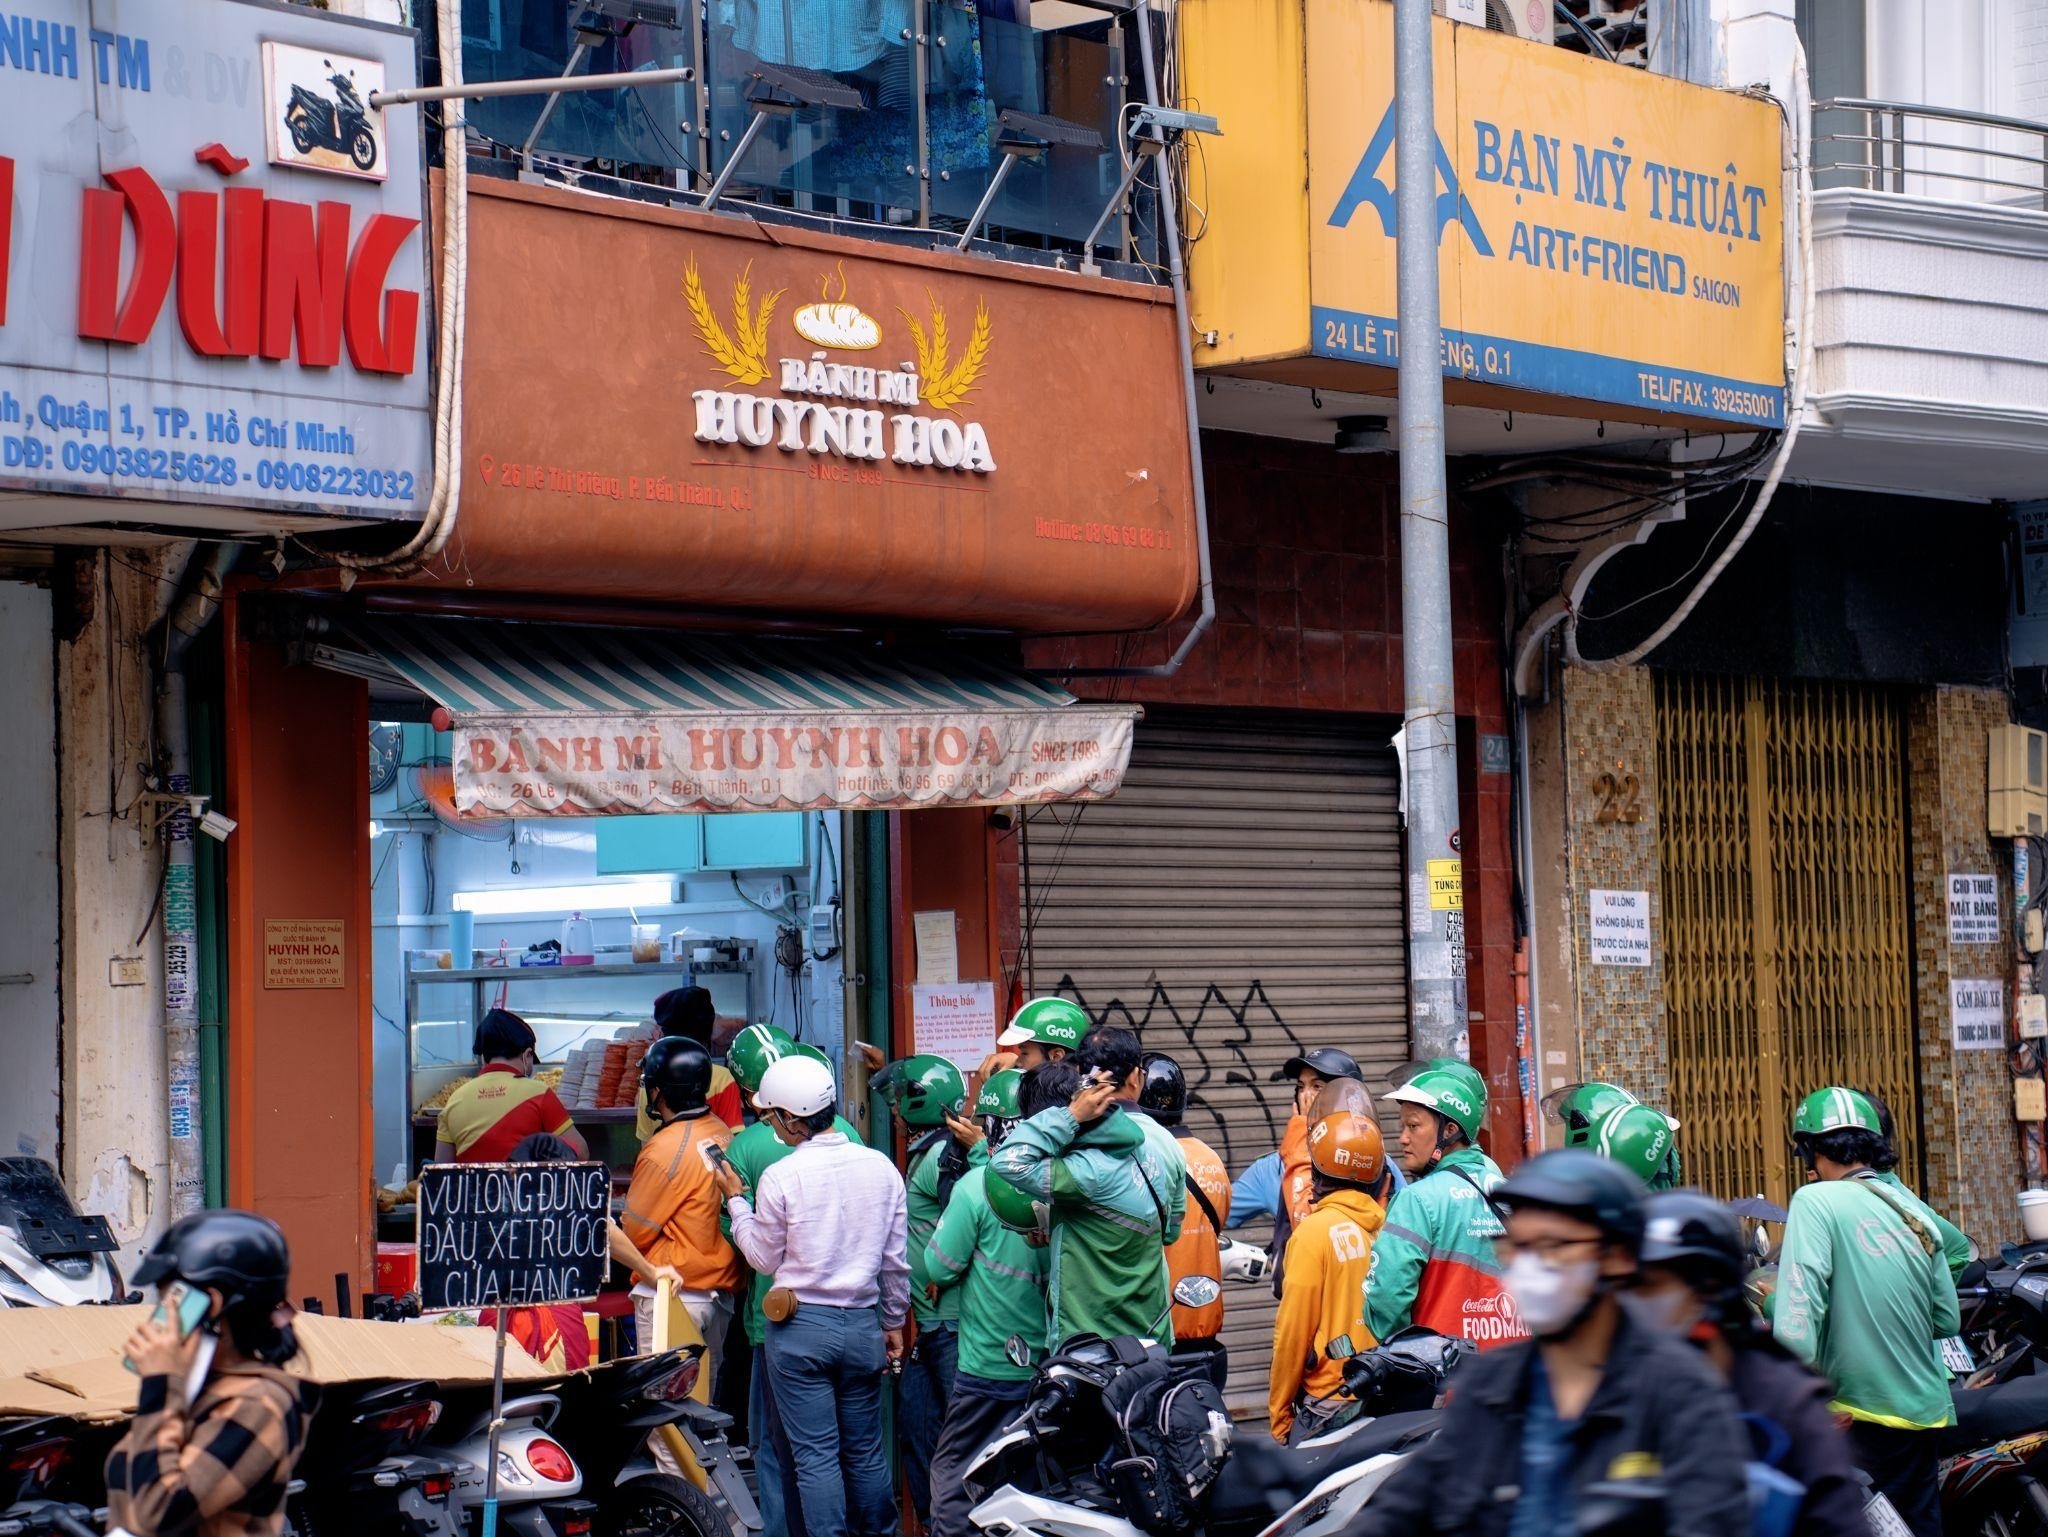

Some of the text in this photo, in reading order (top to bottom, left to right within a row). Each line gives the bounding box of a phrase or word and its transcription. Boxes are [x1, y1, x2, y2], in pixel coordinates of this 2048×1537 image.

[91, 33, 151, 91] TM
[1474, 120, 1767, 252] BẠN MỸ THUẬT
[1693, 275, 1740, 307] SAIGON
[1325, 320, 1348, 349] 24
[1353, 320, 1377, 353] LÊ
[1485, 346, 1512, 375] Q.1
[779, 351, 876, 400] BÁNH
[1638, 373, 1776, 418] TEL/FAX: 39255001
[38, 395, 110, 437] Quận
[153, 407, 197, 440] TP.
[206, 408, 240, 444] Hồ
[247, 416, 288, 449] Chí
[295, 421, 354, 455] Minh
[692, 390, 997, 472] HUYNH HOA
[62, 440, 237, 486] 0903825628
[257, 460, 414, 500] 0908223032
[501, 463, 521, 488] 26
[526, 465, 544, 490] Lê
[550, 467, 572, 497] Thị
[645, 476, 674, 502] Bến
[808, 463, 849, 484] SINCE
[1035, 516, 1082, 541] Hotline:
[469, 725, 1099, 773] BÁNH MÌ HUYNH HOA SINCE 1989
[511, 782, 533, 798] 26
[537, 781, 555, 798] Lê
[837, 775, 893, 791] Hotline:
[916, 774, 931, 789] 96
[1592, 772, 1640, 823] 22
[1604, 896, 1616, 906] VUI
[1636, 918, 1645, 929] XE
[268, 944, 340, 955] HUYNH HOA
[928, 994, 975, 1010] Thông báo
[1046, 1024, 1077, 1040] Grab
[1441, 1091, 1472, 1116] Grab
[1351, 1159, 1373, 1169] Food
[1645, 1129, 1666, 1162] Grab
[176, 1179, 204, 1188] HOND
[423, 1173, 470, 1216] VUI
[424, 1217, 478, 1267] ĐẬU
[487, 1219, 523, 1260] XE
[1856, 1216, 1924, 1258] Gra
[445, 1260, 501, 1307] CỬA
[1782, 1262, 1810, 1340] Grab
